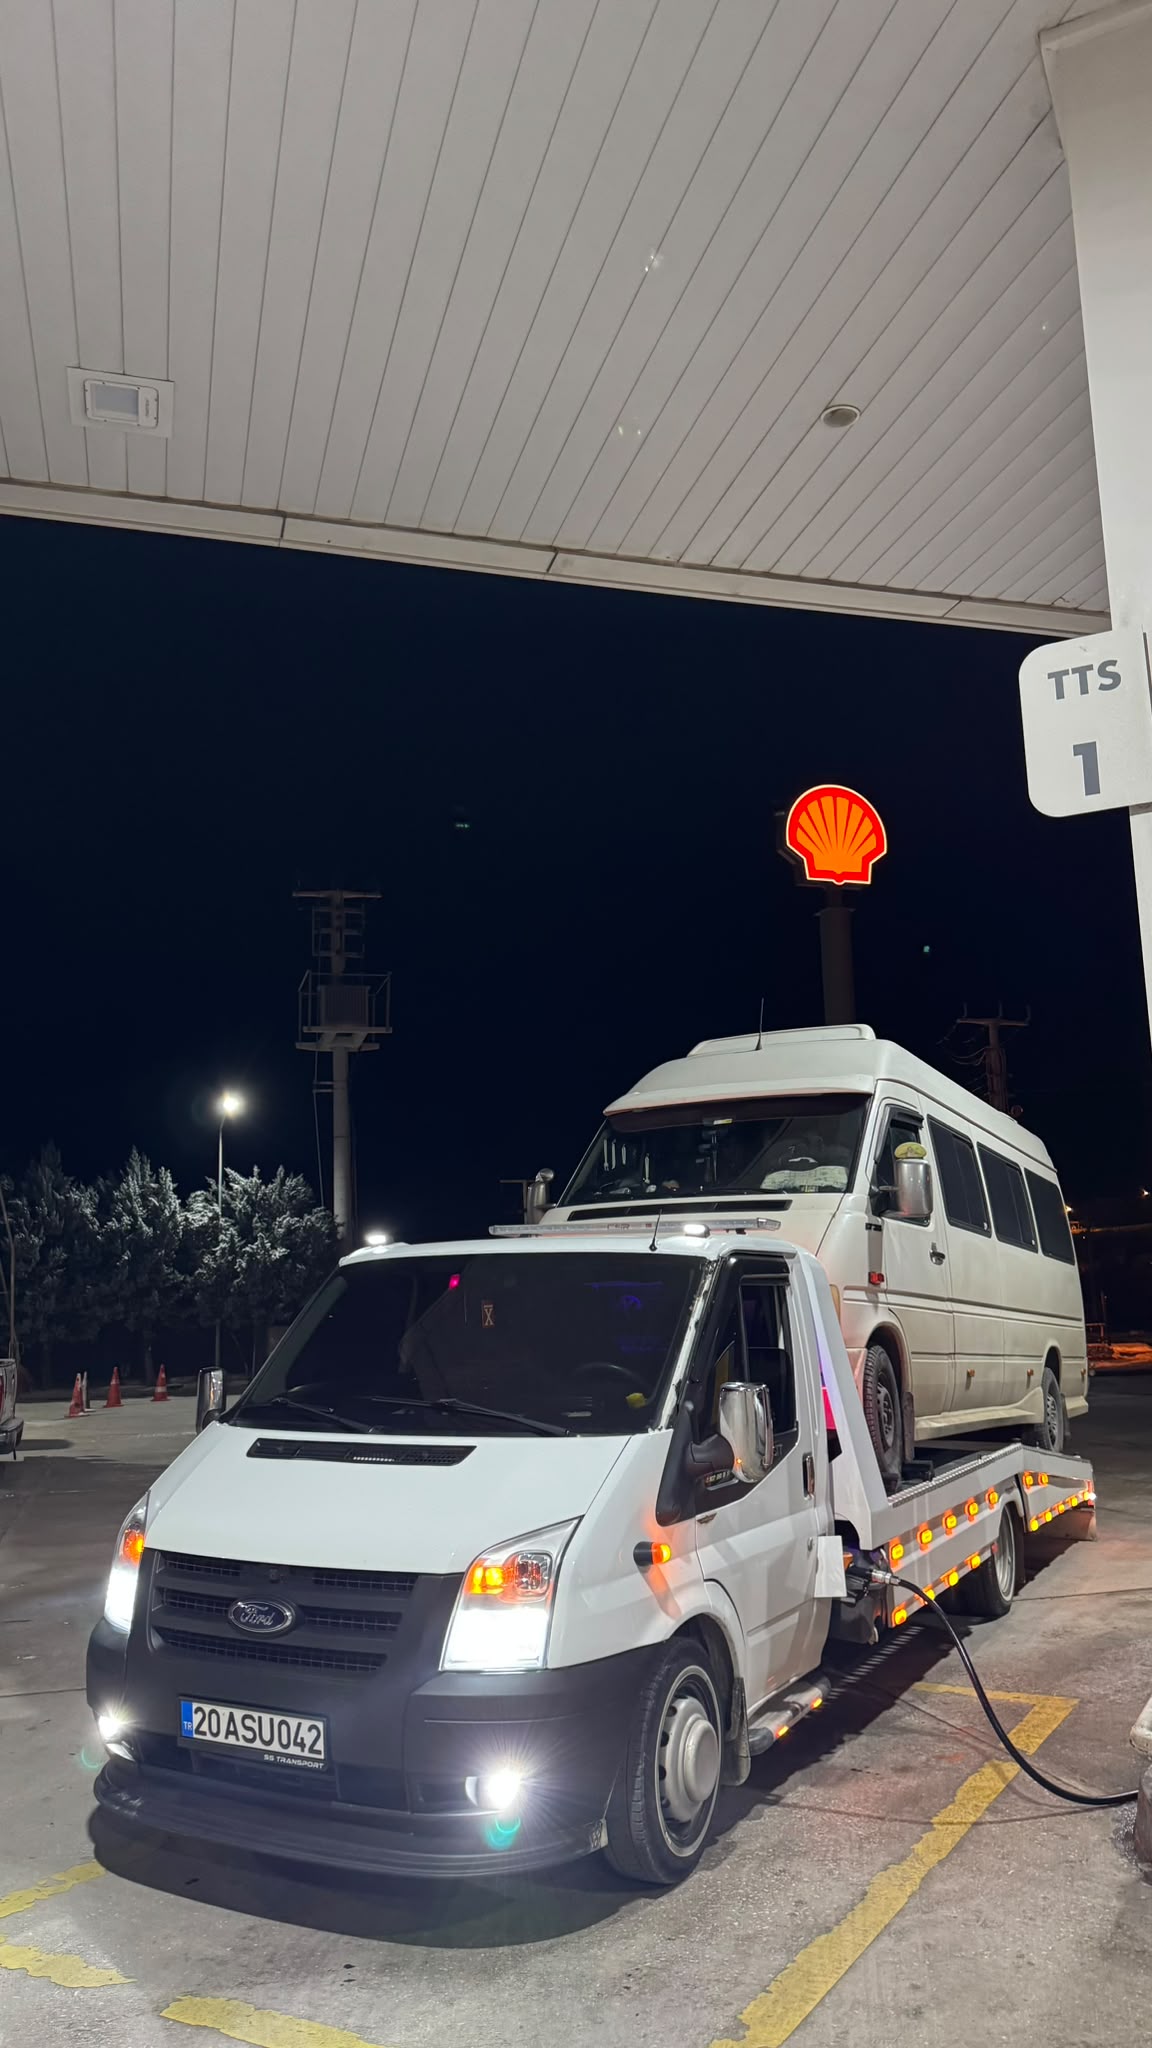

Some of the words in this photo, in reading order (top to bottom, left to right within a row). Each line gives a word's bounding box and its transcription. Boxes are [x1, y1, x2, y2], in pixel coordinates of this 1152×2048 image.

[1047, 659, 1122, 701] TTS
[1072, 741, 1101, 797] 1
[240, 1604, 276, 1626] Ford
[183, 1720, 193, 1732] TR
[276, 1756, 324, 1769] TRANSPORT
